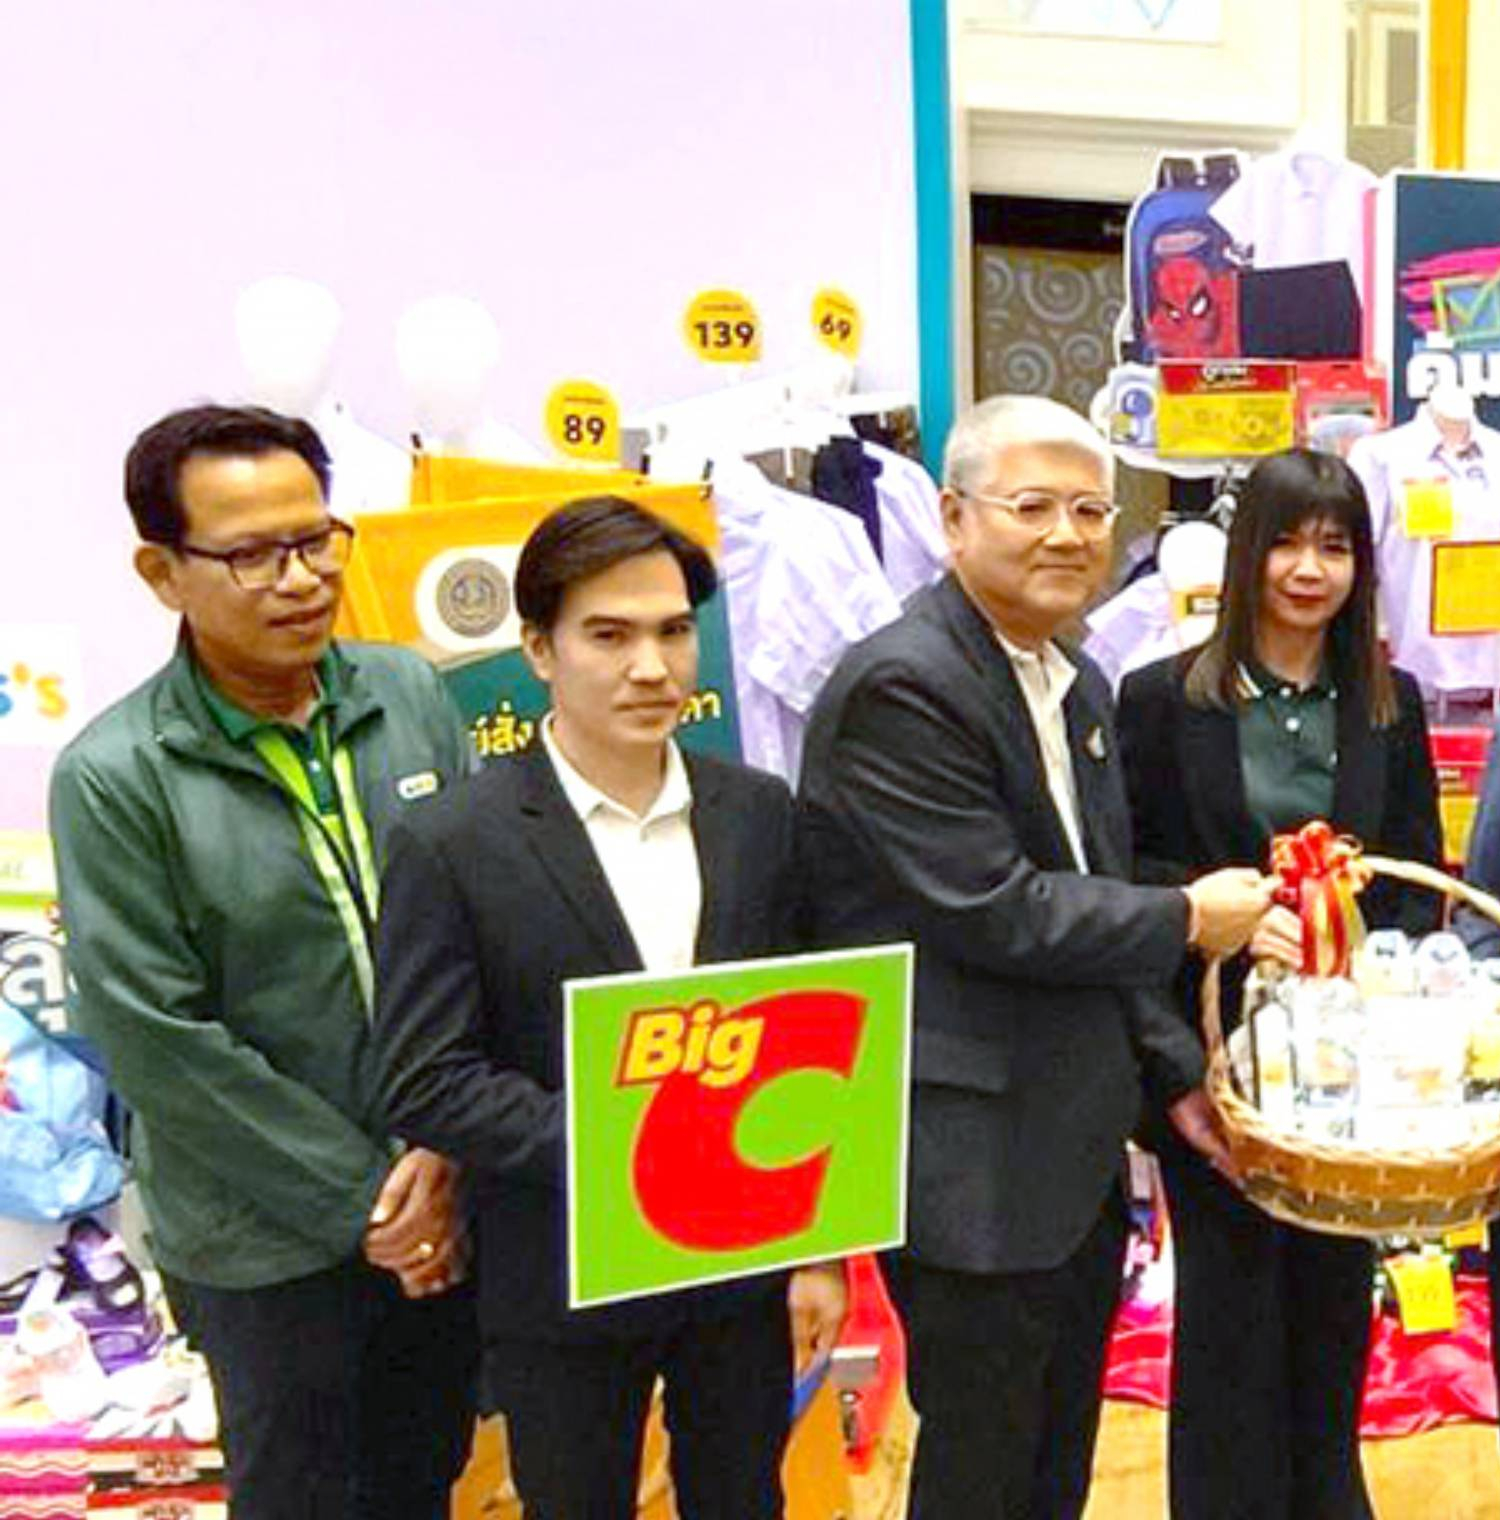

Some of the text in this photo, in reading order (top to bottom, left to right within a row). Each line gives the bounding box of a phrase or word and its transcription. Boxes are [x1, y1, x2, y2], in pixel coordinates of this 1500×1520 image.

[694, 320, 755, 349] 139
[819, 313, 852, 342] 69
[563, 413, 606, 446] 89
[617, 989, 868, 1253] Big C
